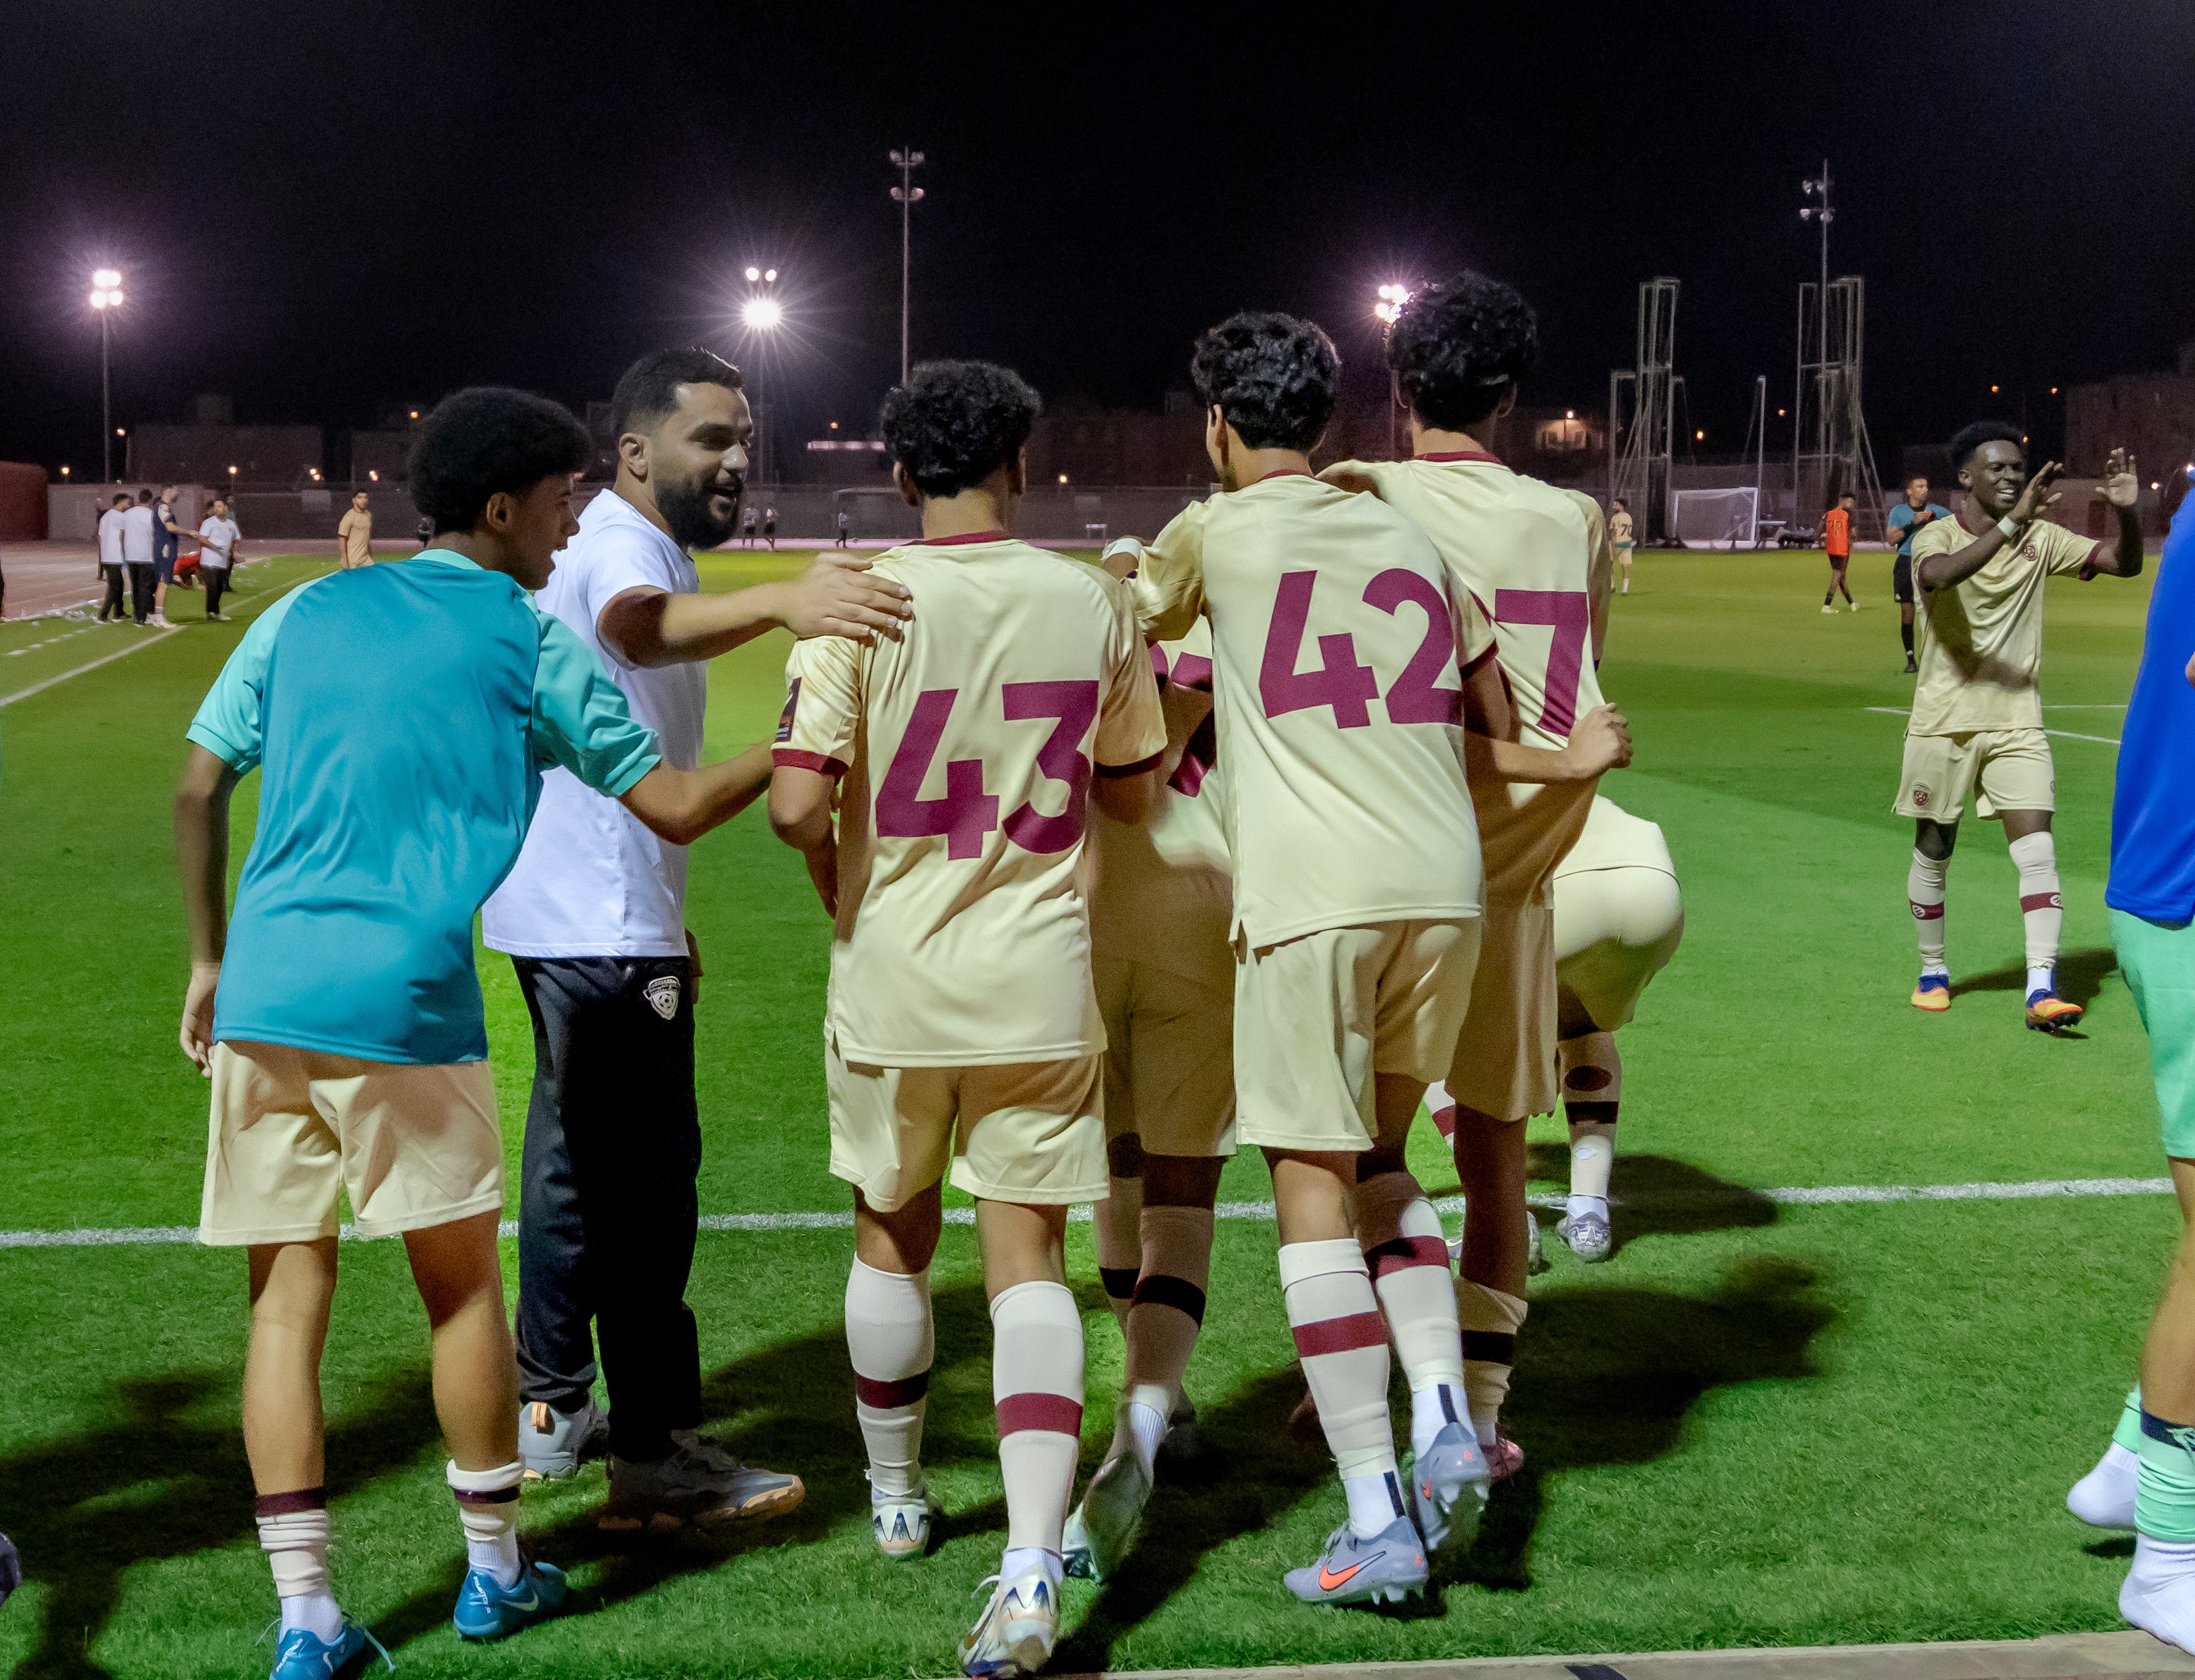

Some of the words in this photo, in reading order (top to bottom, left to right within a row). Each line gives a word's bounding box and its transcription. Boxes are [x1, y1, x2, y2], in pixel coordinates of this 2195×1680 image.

[1259, 568, 1464, 729] 42
[1468, 589, 1589, 737] 7
[876, 680, 1100, 861] 43
